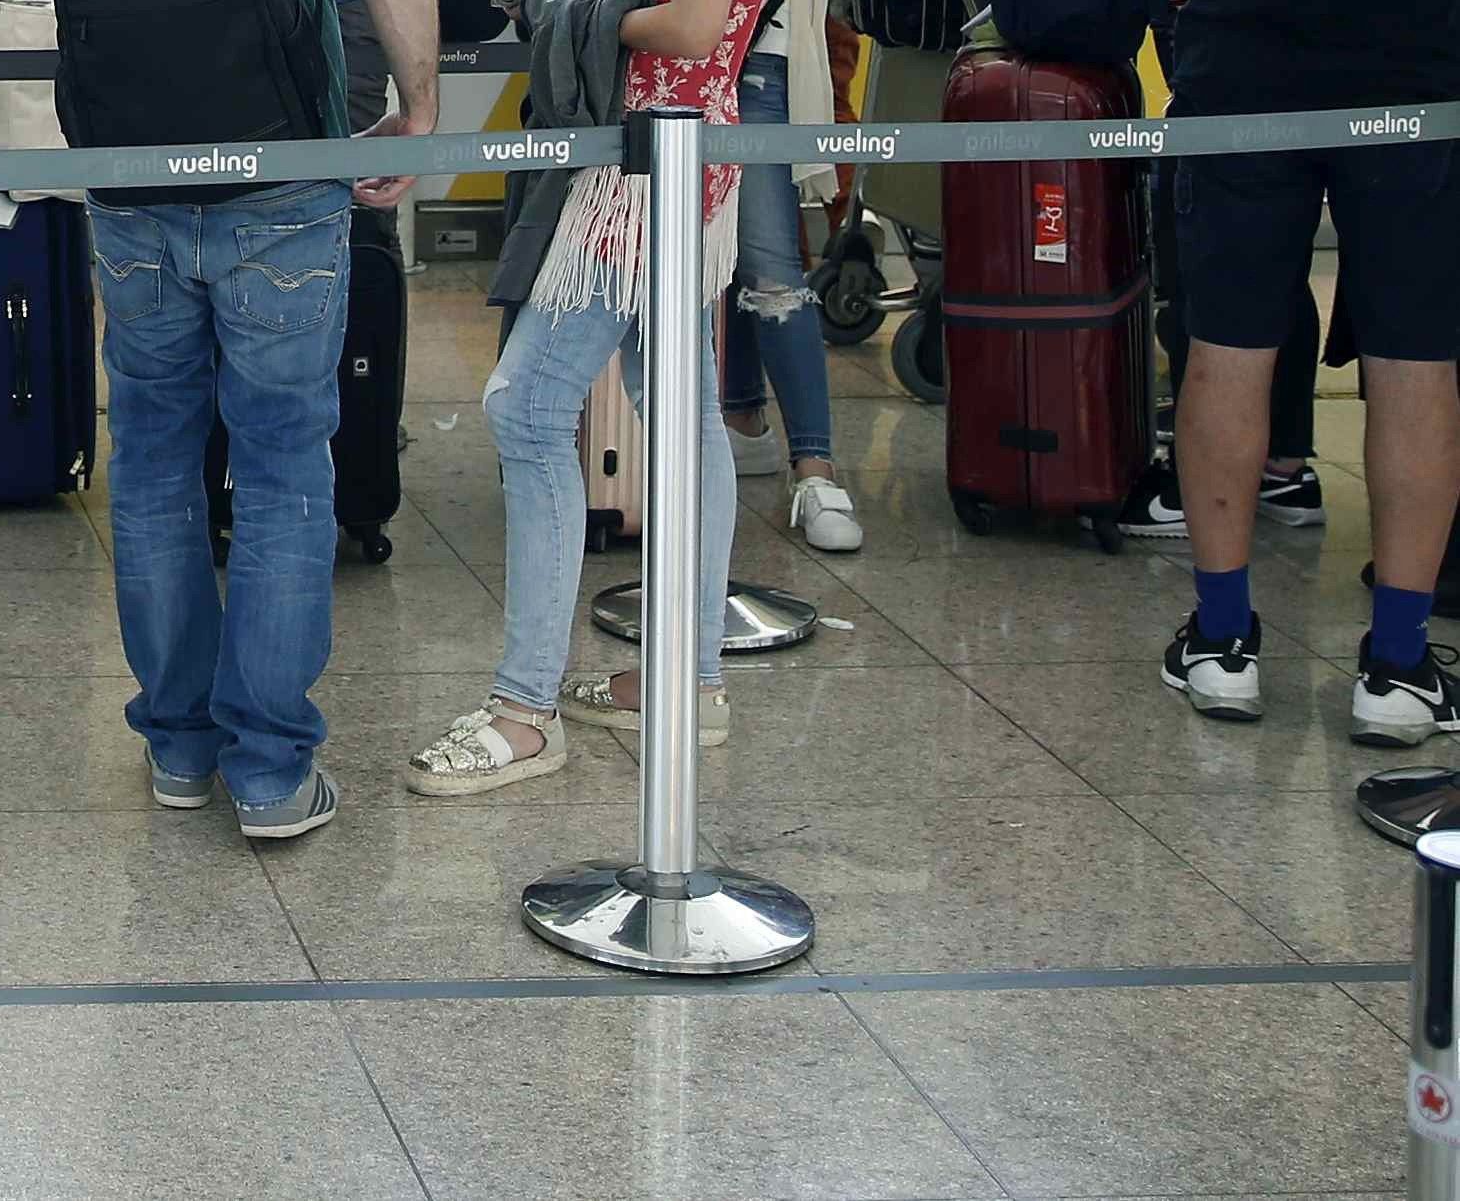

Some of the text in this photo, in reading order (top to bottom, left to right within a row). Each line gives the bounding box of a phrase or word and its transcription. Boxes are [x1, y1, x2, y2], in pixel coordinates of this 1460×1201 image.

[1089, 123, 1169, 153] vueling
[1349, 109, 1426, 139] vueling
[482, 133, 576, 164] vueling
[816, 128, 901, 159] vueling
[167, 147, 264, 179] vueling
